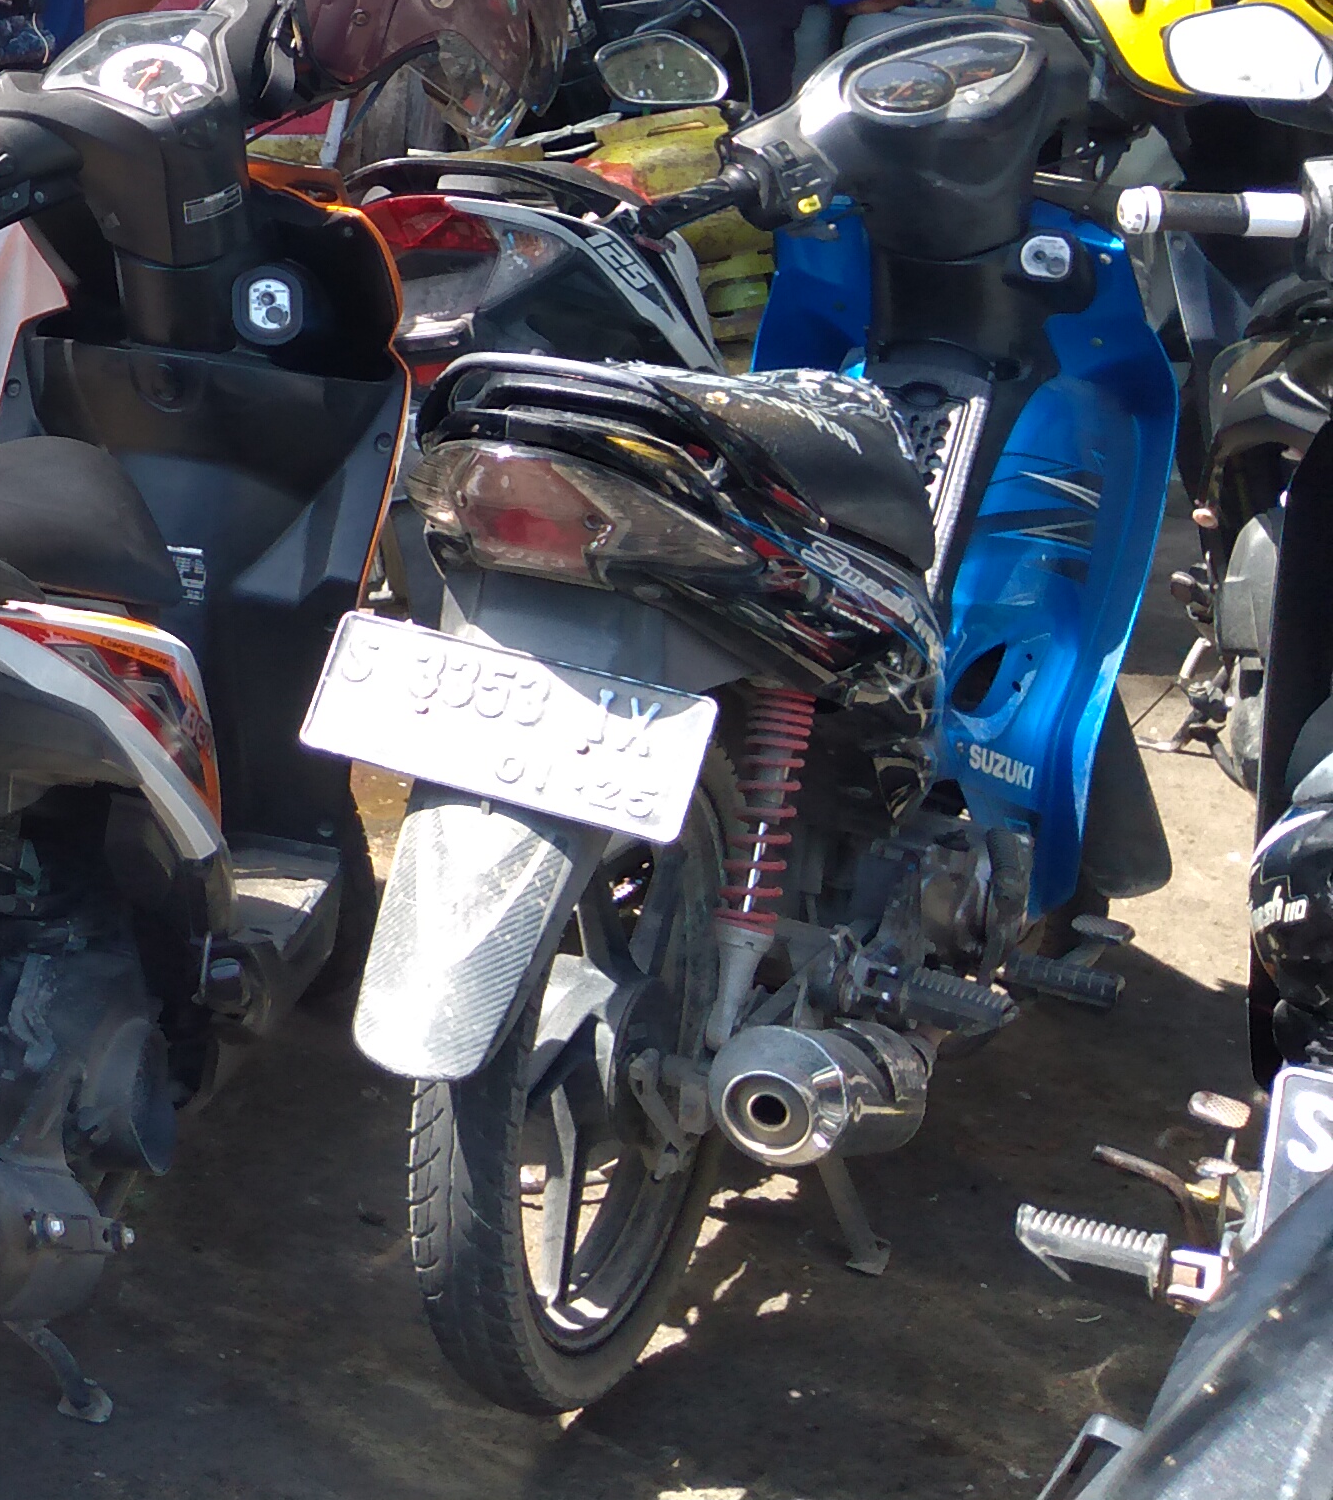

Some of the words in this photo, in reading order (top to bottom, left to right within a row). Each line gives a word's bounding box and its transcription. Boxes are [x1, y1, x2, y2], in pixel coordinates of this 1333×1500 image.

[584, 231, 650, 291] 125
[340, 636, 380, 683] S
[968, 743, 1035, 791] SUZUKI
